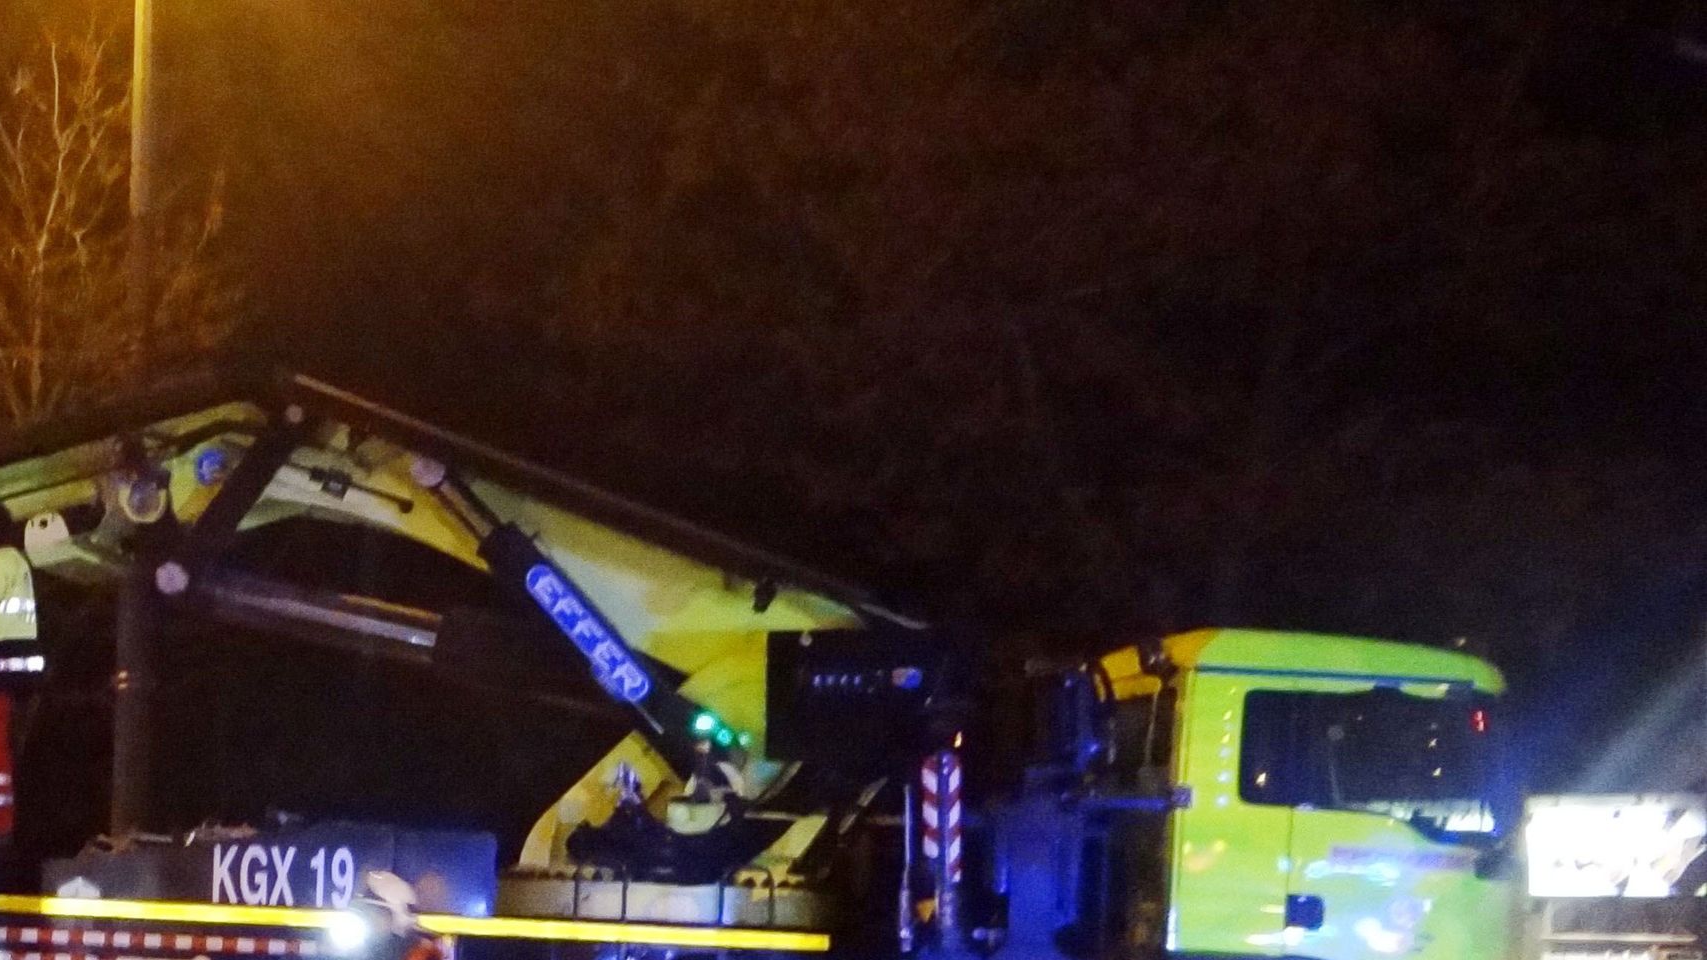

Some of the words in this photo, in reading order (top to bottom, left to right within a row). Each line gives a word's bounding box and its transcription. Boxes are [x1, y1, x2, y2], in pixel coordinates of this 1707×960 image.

[532, 573, 644, 697] EFFER
[212, 843, 297, 906] KGX
[310, 847, 355, 909] 19
